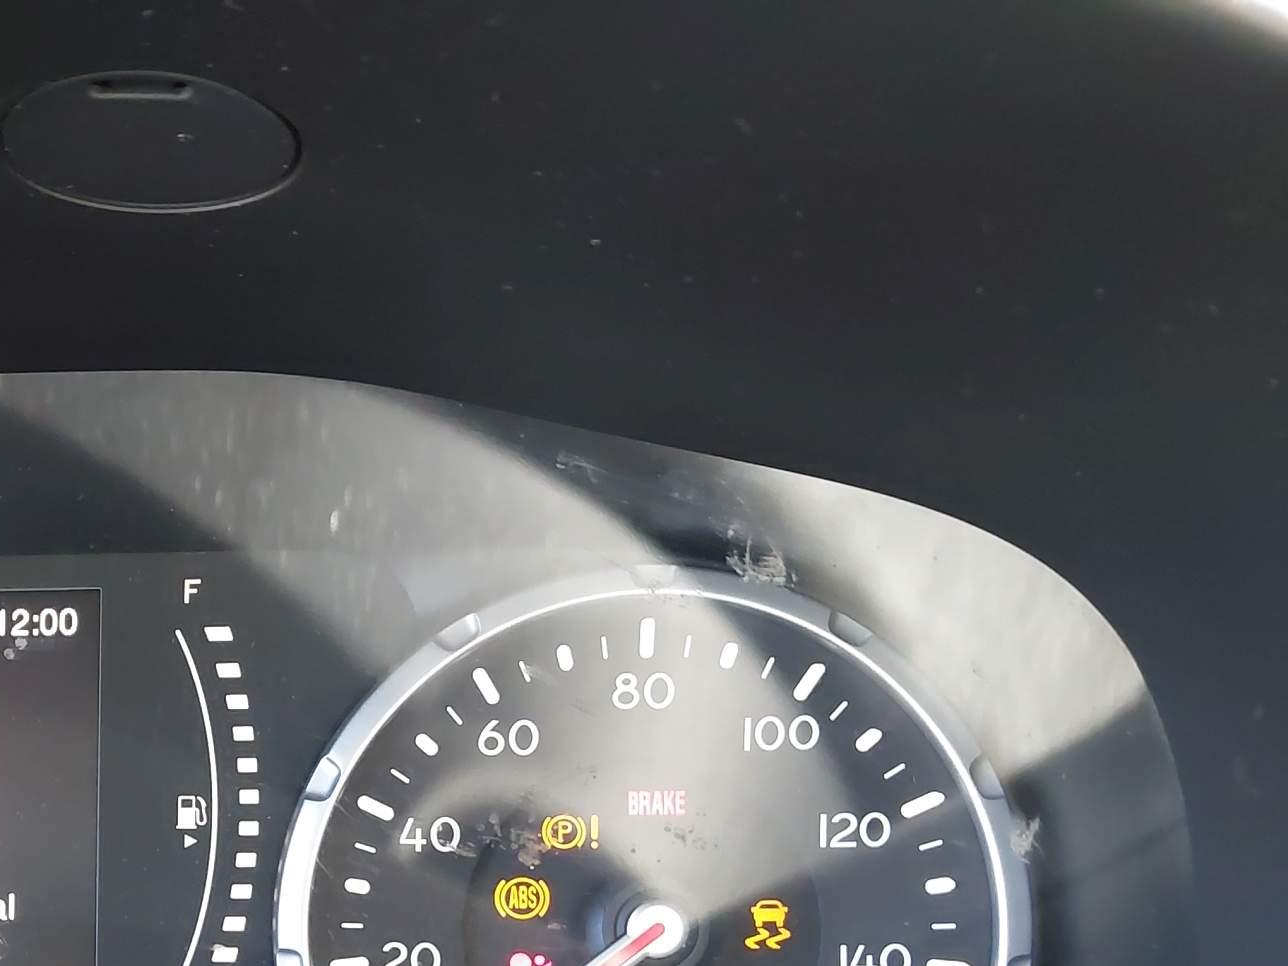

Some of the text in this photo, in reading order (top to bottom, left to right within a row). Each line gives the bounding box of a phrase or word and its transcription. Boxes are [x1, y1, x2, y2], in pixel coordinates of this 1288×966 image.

[183, 578, 202, 604] F
[612, 672, 676, 710] 80
[477, 719, 540, 756] 60
[742, 714, 821, 752] 100
[627, 790, 687, 816] BRAKE
[399, 816, 461, 853] 40
[819, 811, 891, 849] 120
[508, 884, 538, 911] ABS
